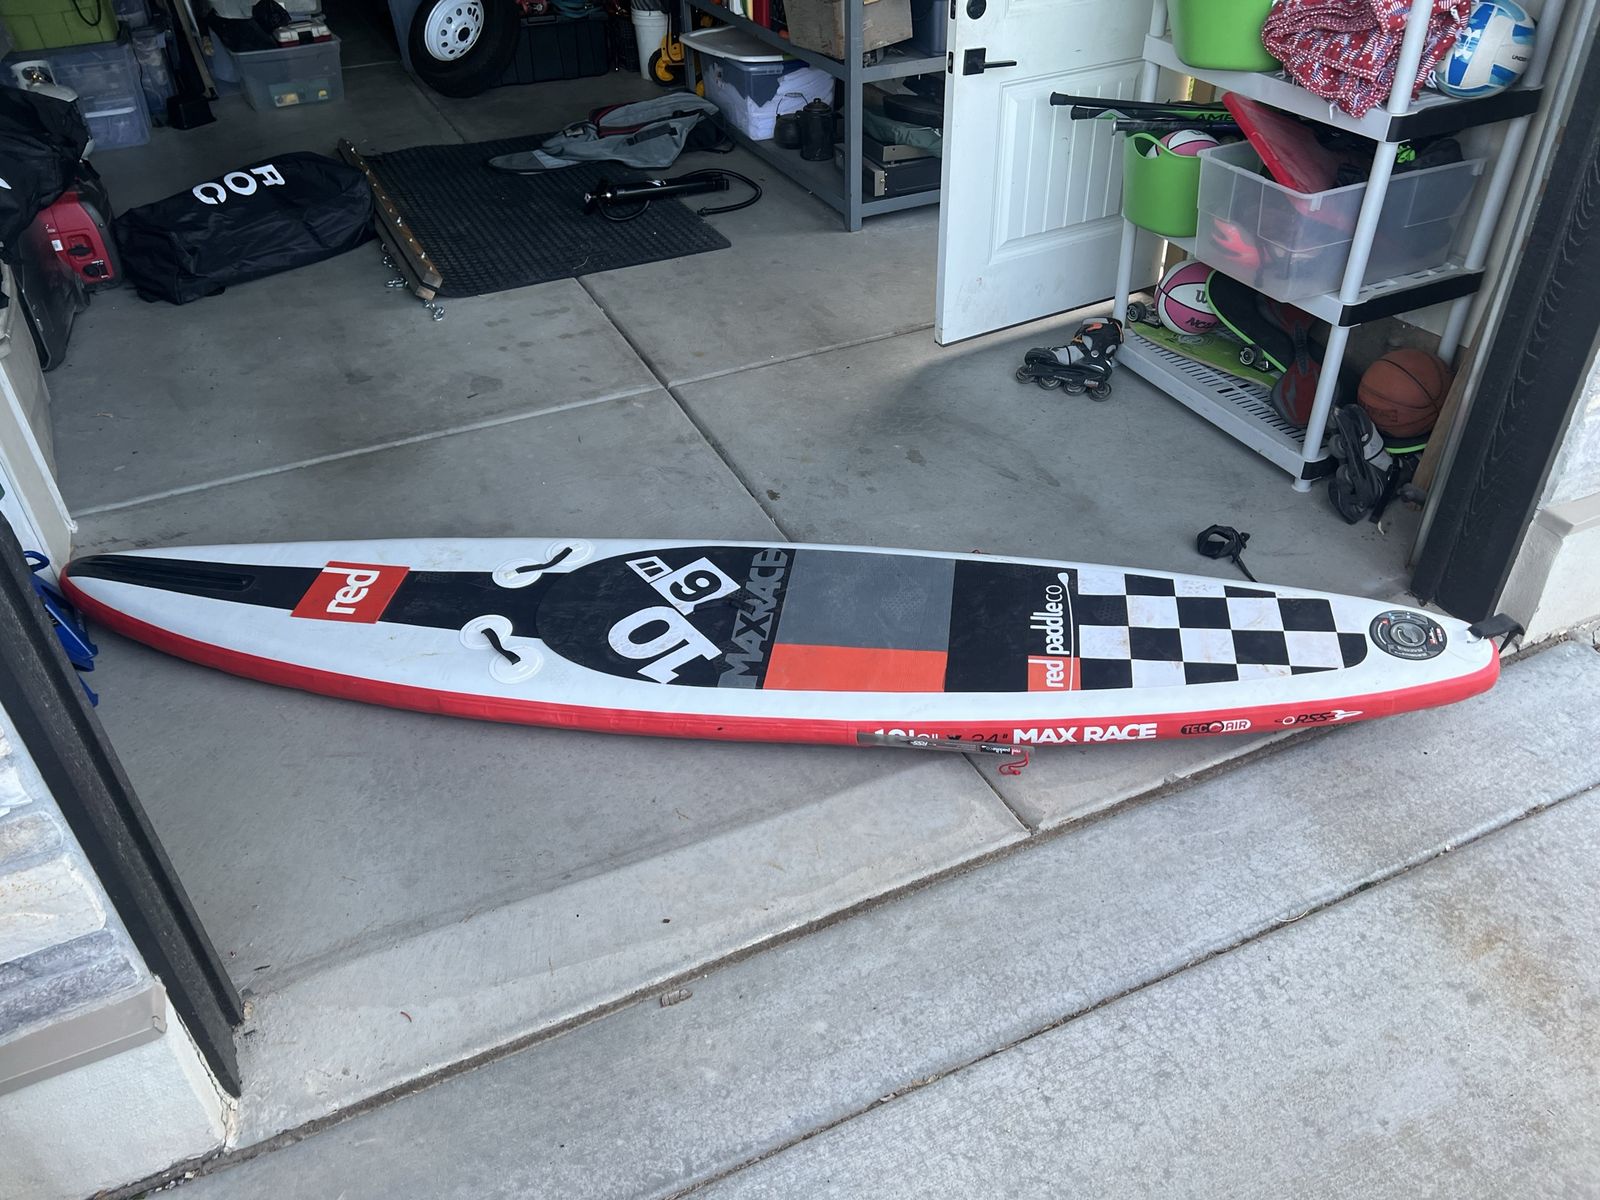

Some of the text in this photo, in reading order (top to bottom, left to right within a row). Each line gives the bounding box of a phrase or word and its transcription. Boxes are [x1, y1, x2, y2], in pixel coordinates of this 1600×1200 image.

[192, 163, 286, 205] ROC
[321, 566, 381, 615] red
[607, 604, 723, 685] 10
[1027, 658, 1065, 688] red
[1013, 726, 1079, 744] MAX
[1083, 722, 1158, 742] RACE
